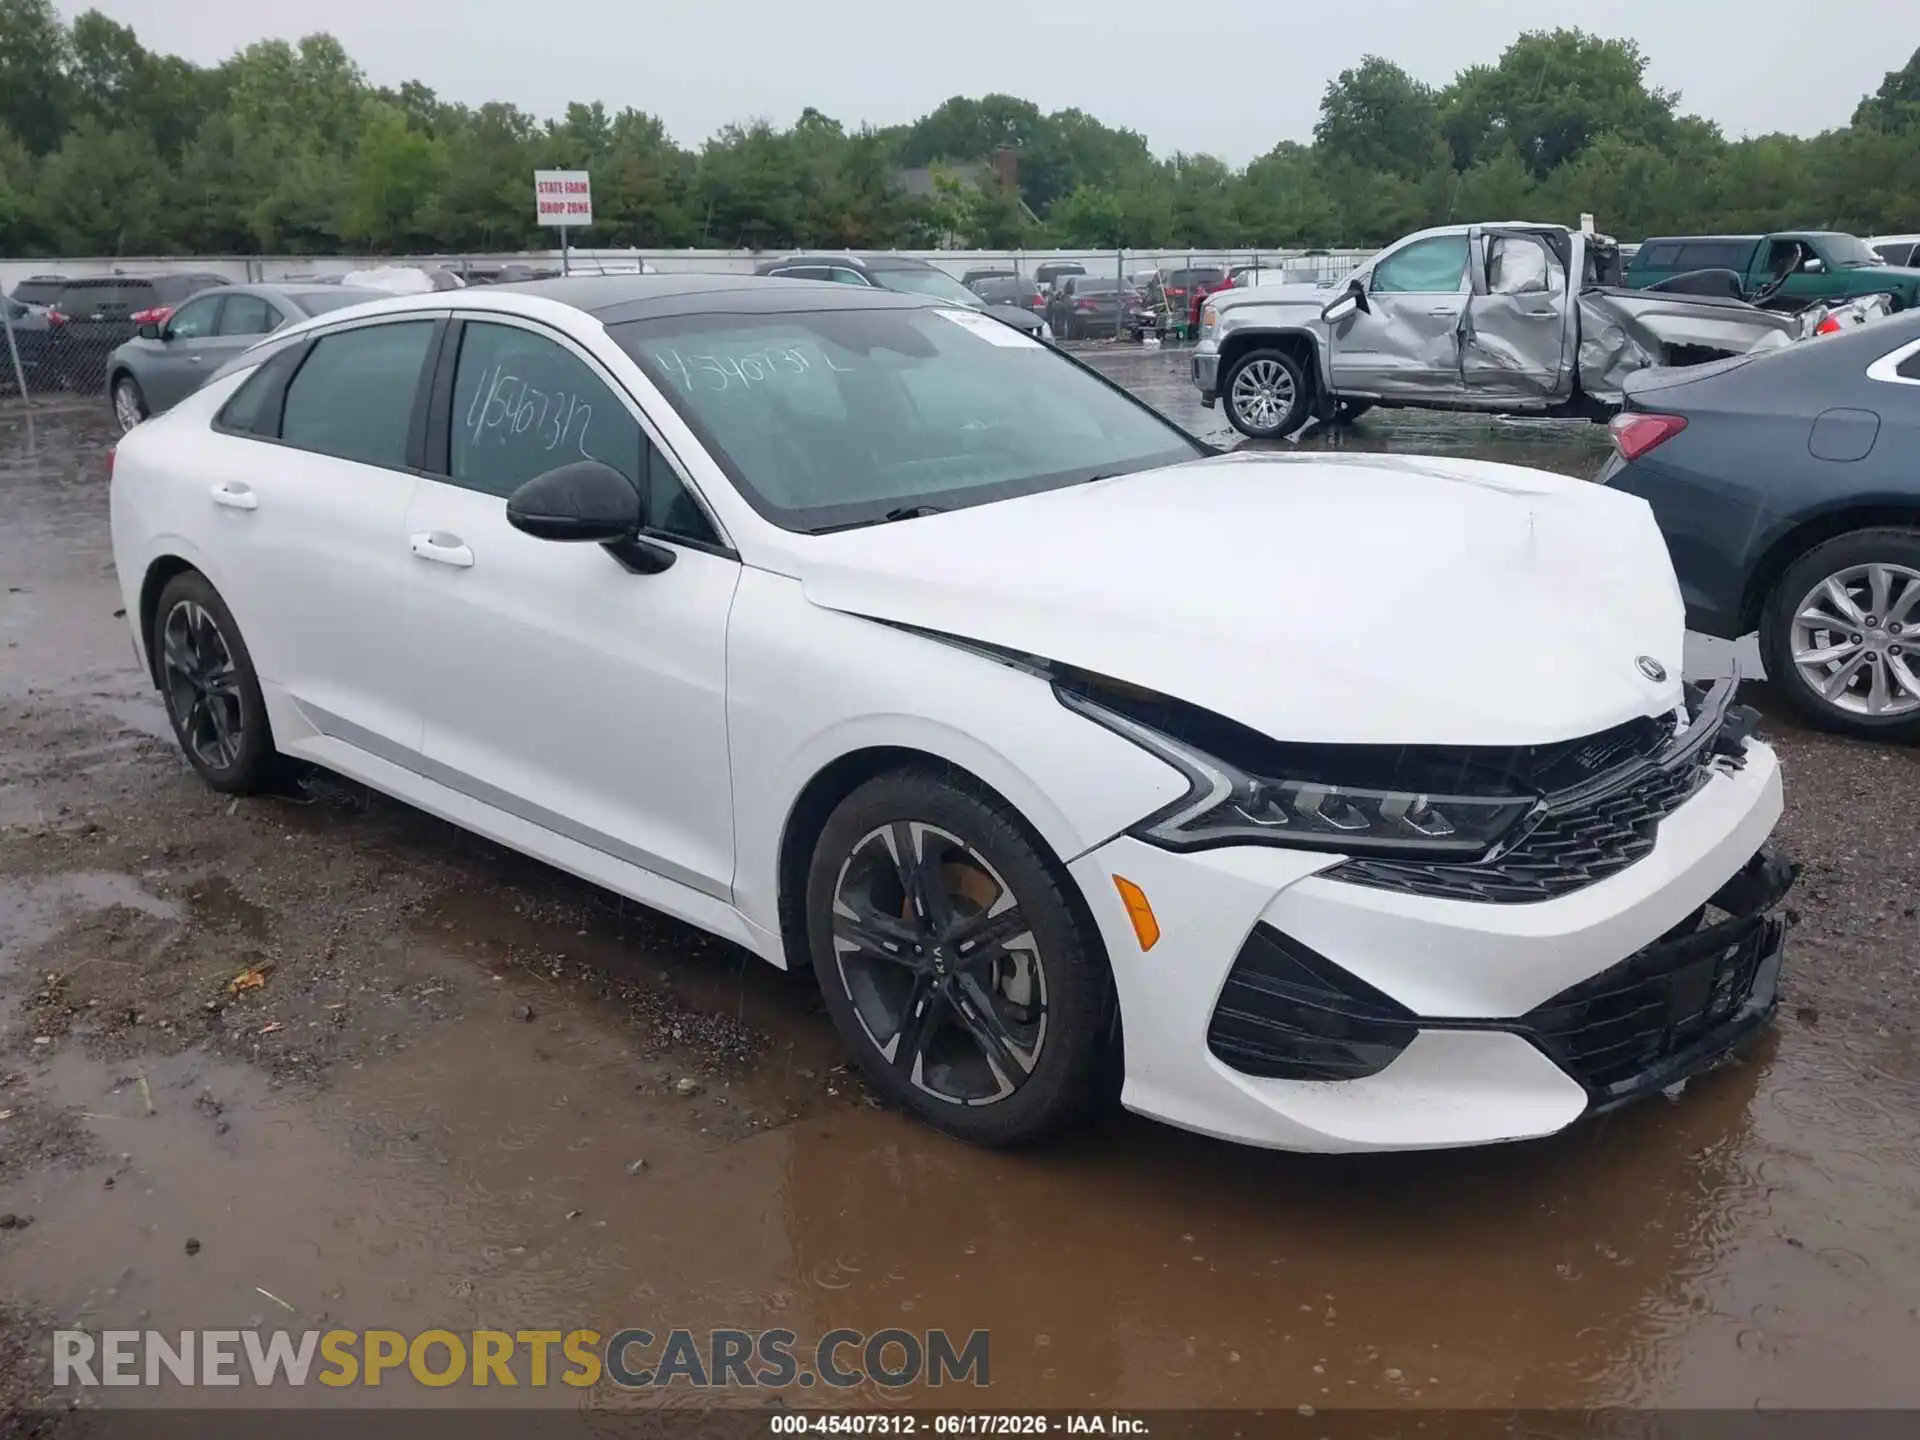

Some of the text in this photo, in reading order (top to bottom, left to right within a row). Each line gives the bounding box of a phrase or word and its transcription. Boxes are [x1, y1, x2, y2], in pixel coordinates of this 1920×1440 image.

[538, 182, 588, 193] STATE FARM
[540, 202, 590, 214] DROP ZONE
[466, 364, 596, 461] 45407312
